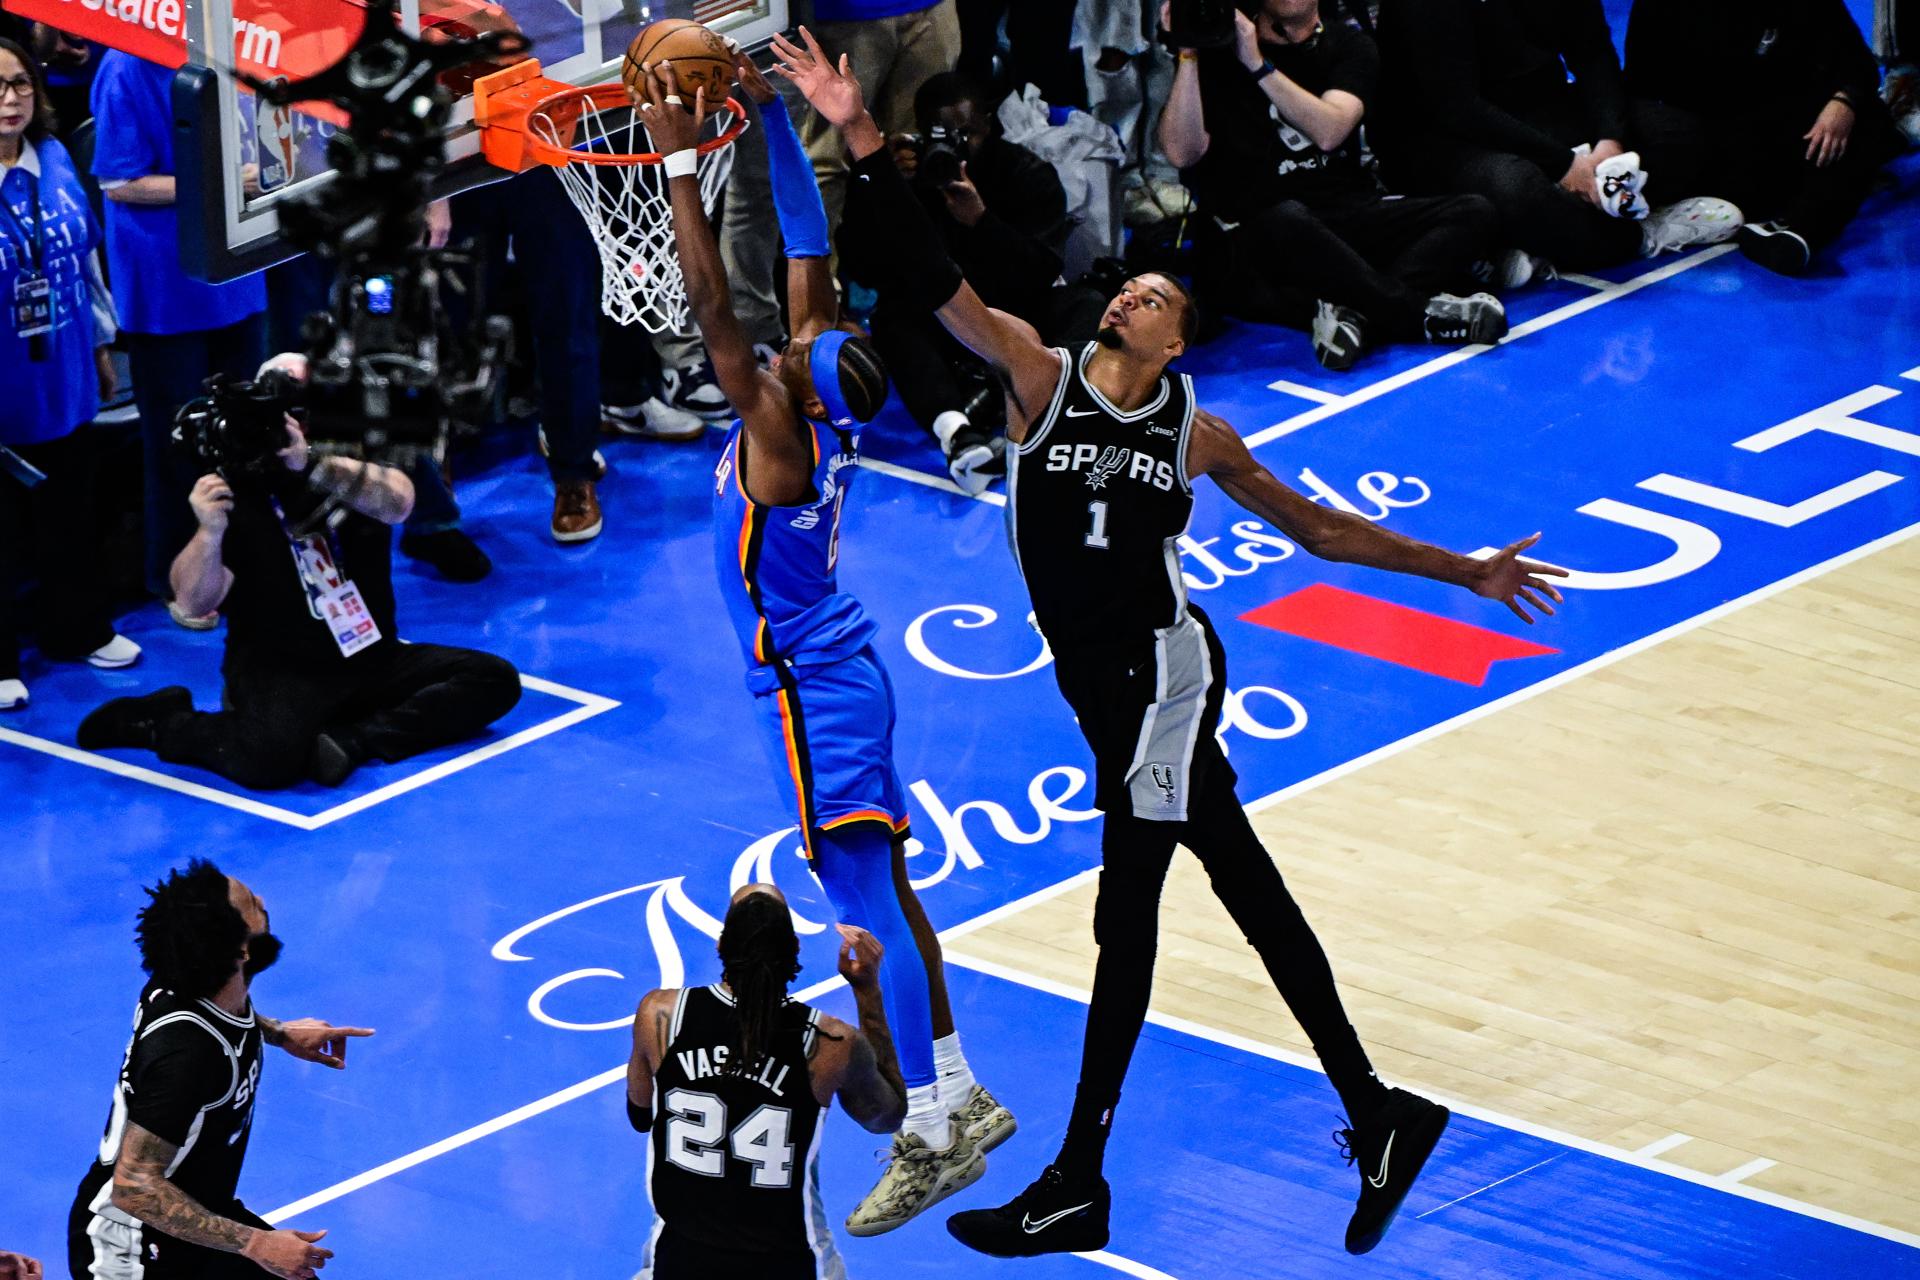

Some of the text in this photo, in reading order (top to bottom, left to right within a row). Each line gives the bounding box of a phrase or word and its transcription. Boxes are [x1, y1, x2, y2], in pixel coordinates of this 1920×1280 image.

[73, 0, 184, 36] tate
[1465, 366, 1920, 591] ULT
[1085, 500, 1110, 549] 1
[676, 1045, 790, 1097] VASLL
[664, 1086, 796, 1189] 24
